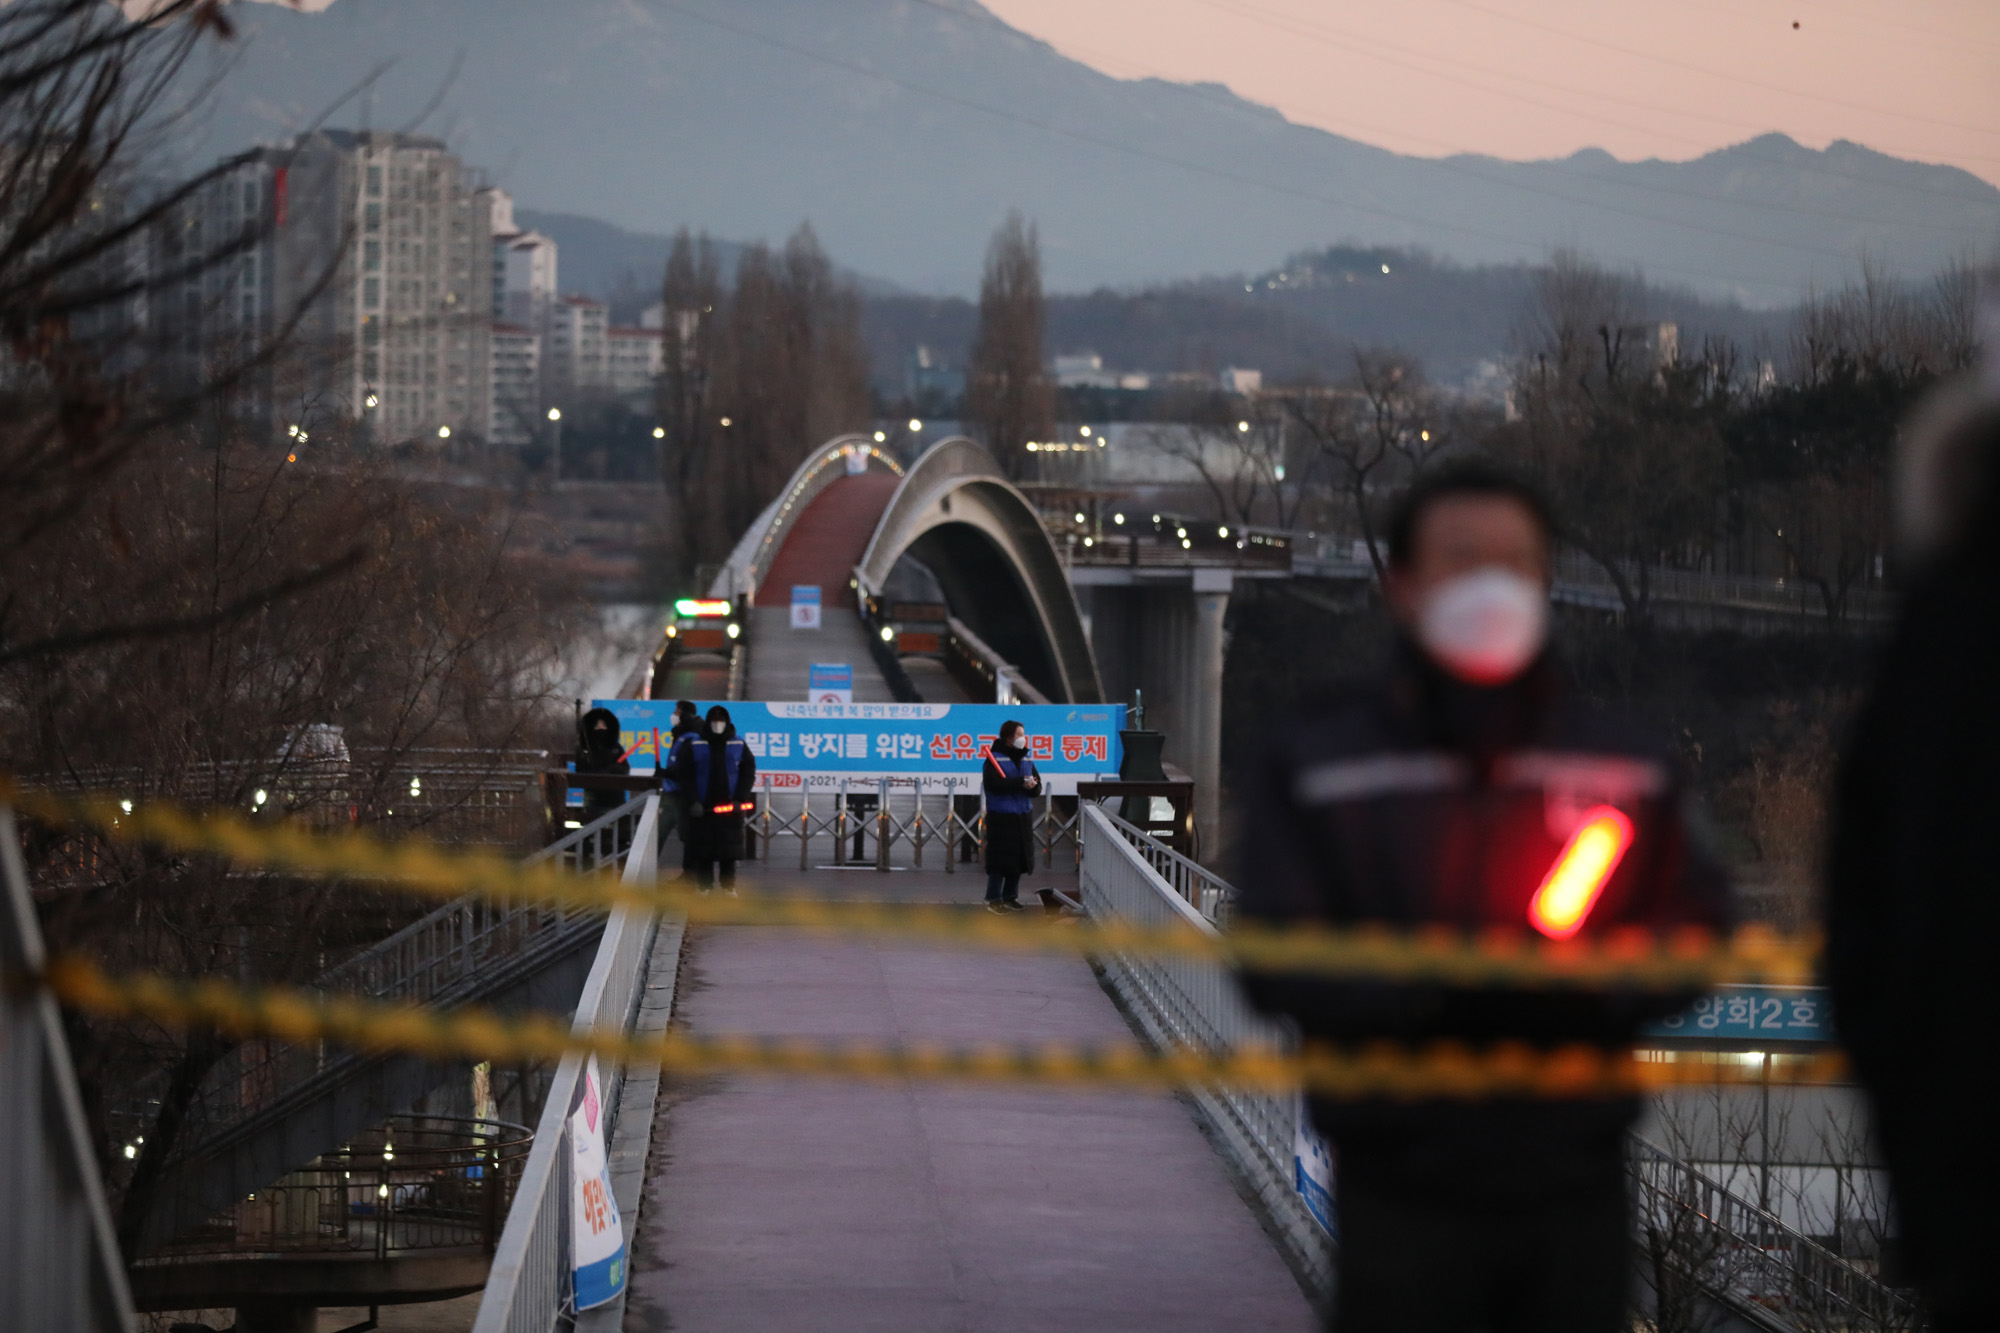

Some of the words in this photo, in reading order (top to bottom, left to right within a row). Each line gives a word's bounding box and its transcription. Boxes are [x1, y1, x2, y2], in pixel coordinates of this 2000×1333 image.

[823, 705, 844, 716] 새해
[849, 705, 858, 717] 복
[863, 705, 885, 718] 많이
[889, 705, 932, 717] 받으세요
[745, 732, 790, 757] 밀집
[798, 733, 868, 758] 방지를
[875, 733, 924, 759] 위한
[1023, 735, 1053, 760] 면
[1061, 735, 1107, 761] 통제
